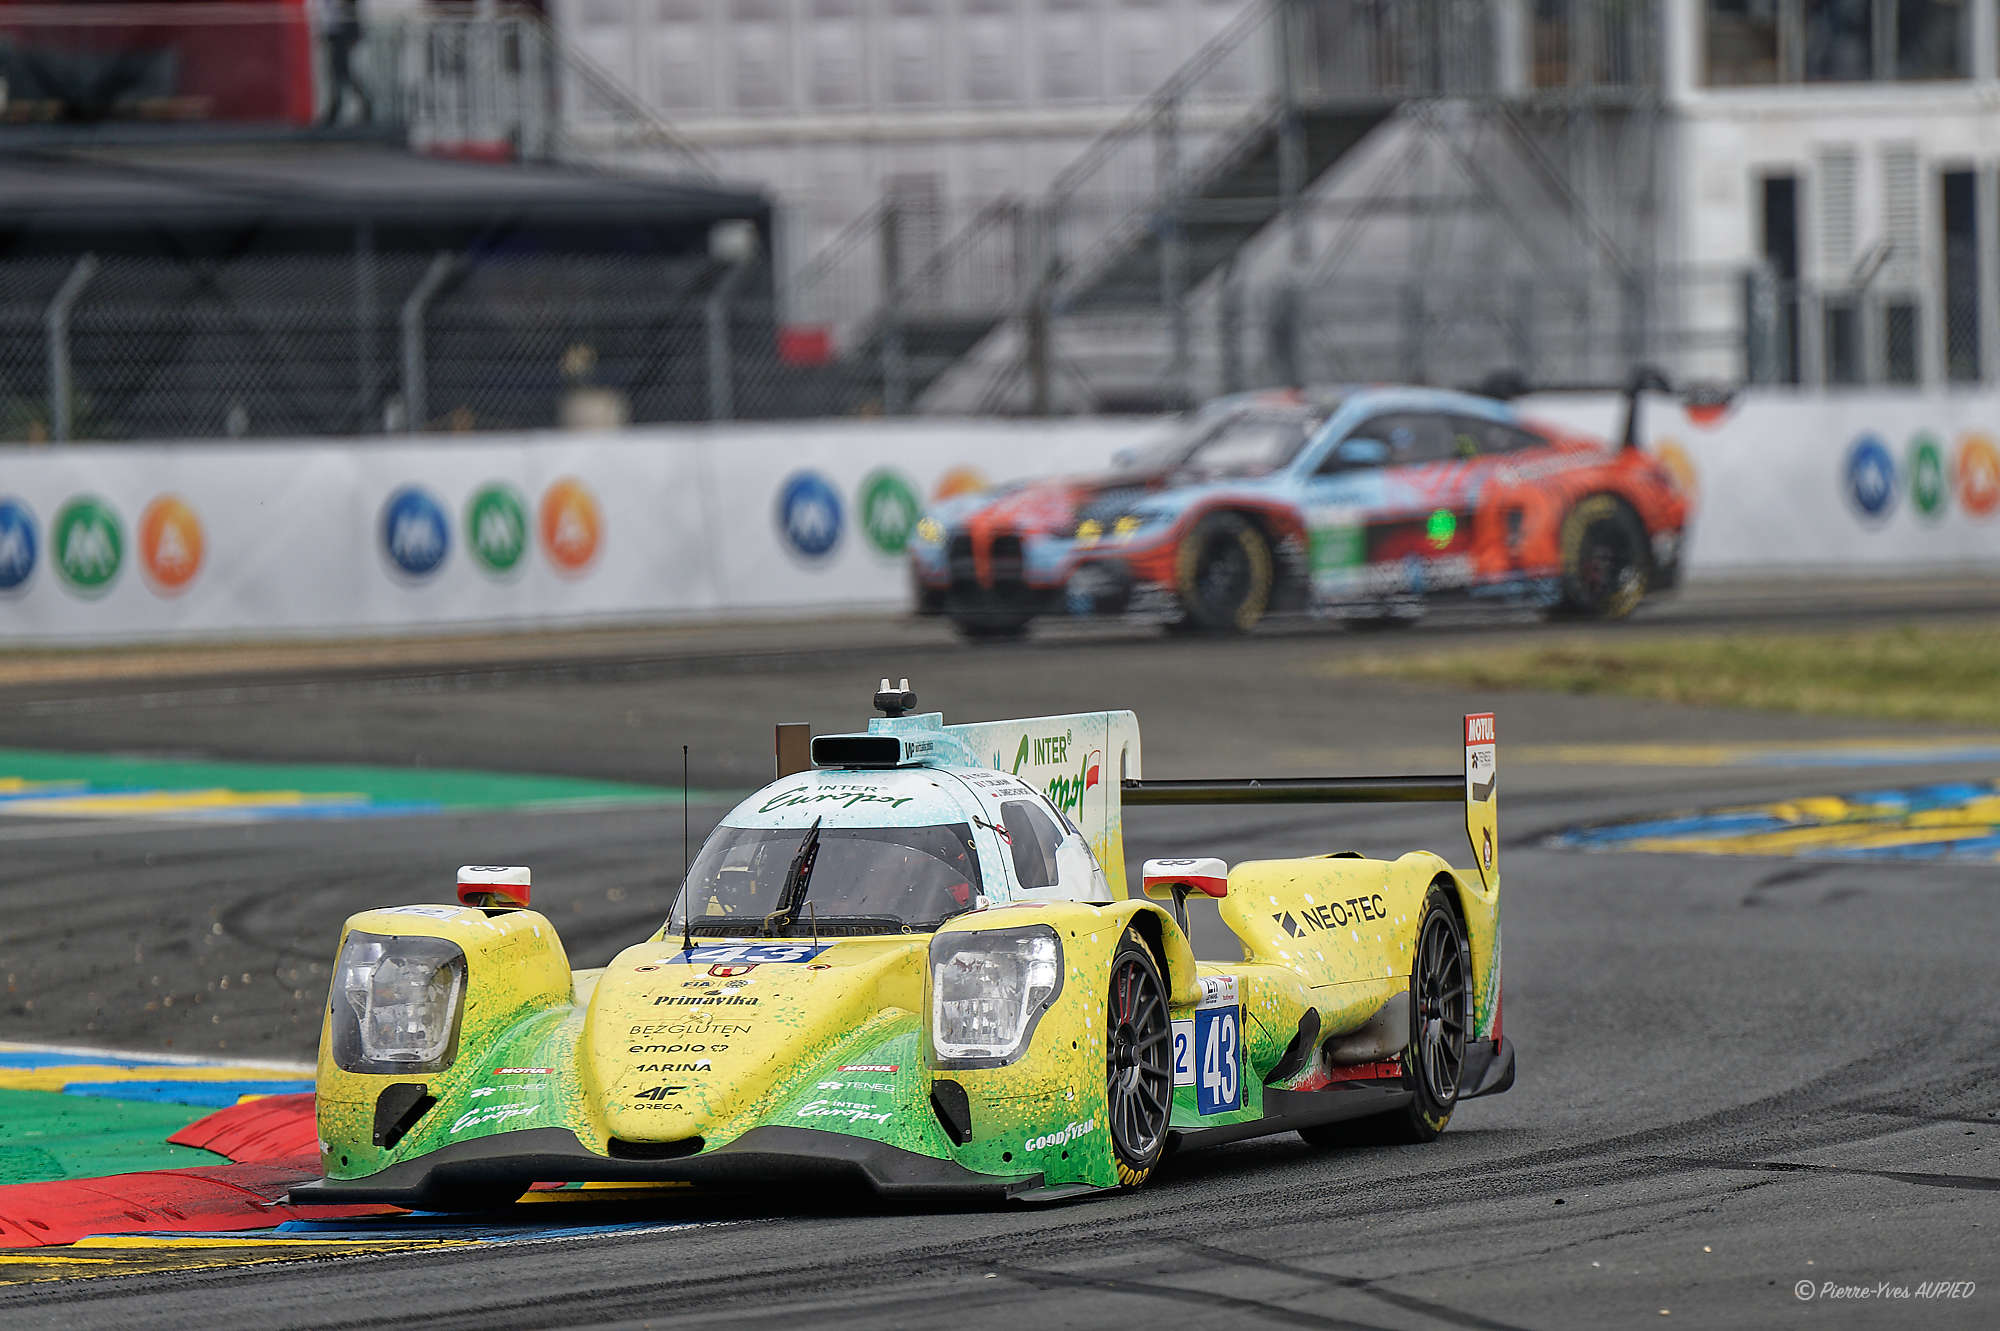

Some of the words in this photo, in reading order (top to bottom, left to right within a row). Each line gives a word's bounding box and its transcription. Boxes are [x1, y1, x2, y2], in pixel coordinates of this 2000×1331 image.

[1468, 718, 1495, 742] MOTUL
[1300, 894, 1387, 932] NEO-TEC
[688, 945, 812, 964] 43
[682, 980, 711, 988] FIA
[653, 996, 759, 1006] Primavika
[629, 1025, 752, 1035] BEZGLUTEN
[628, 1043, 706, 1054] emplo
[1203, 1014, 1237, 1105] 43
[1025, 1119, 1095, 1152] GOODYEAR
